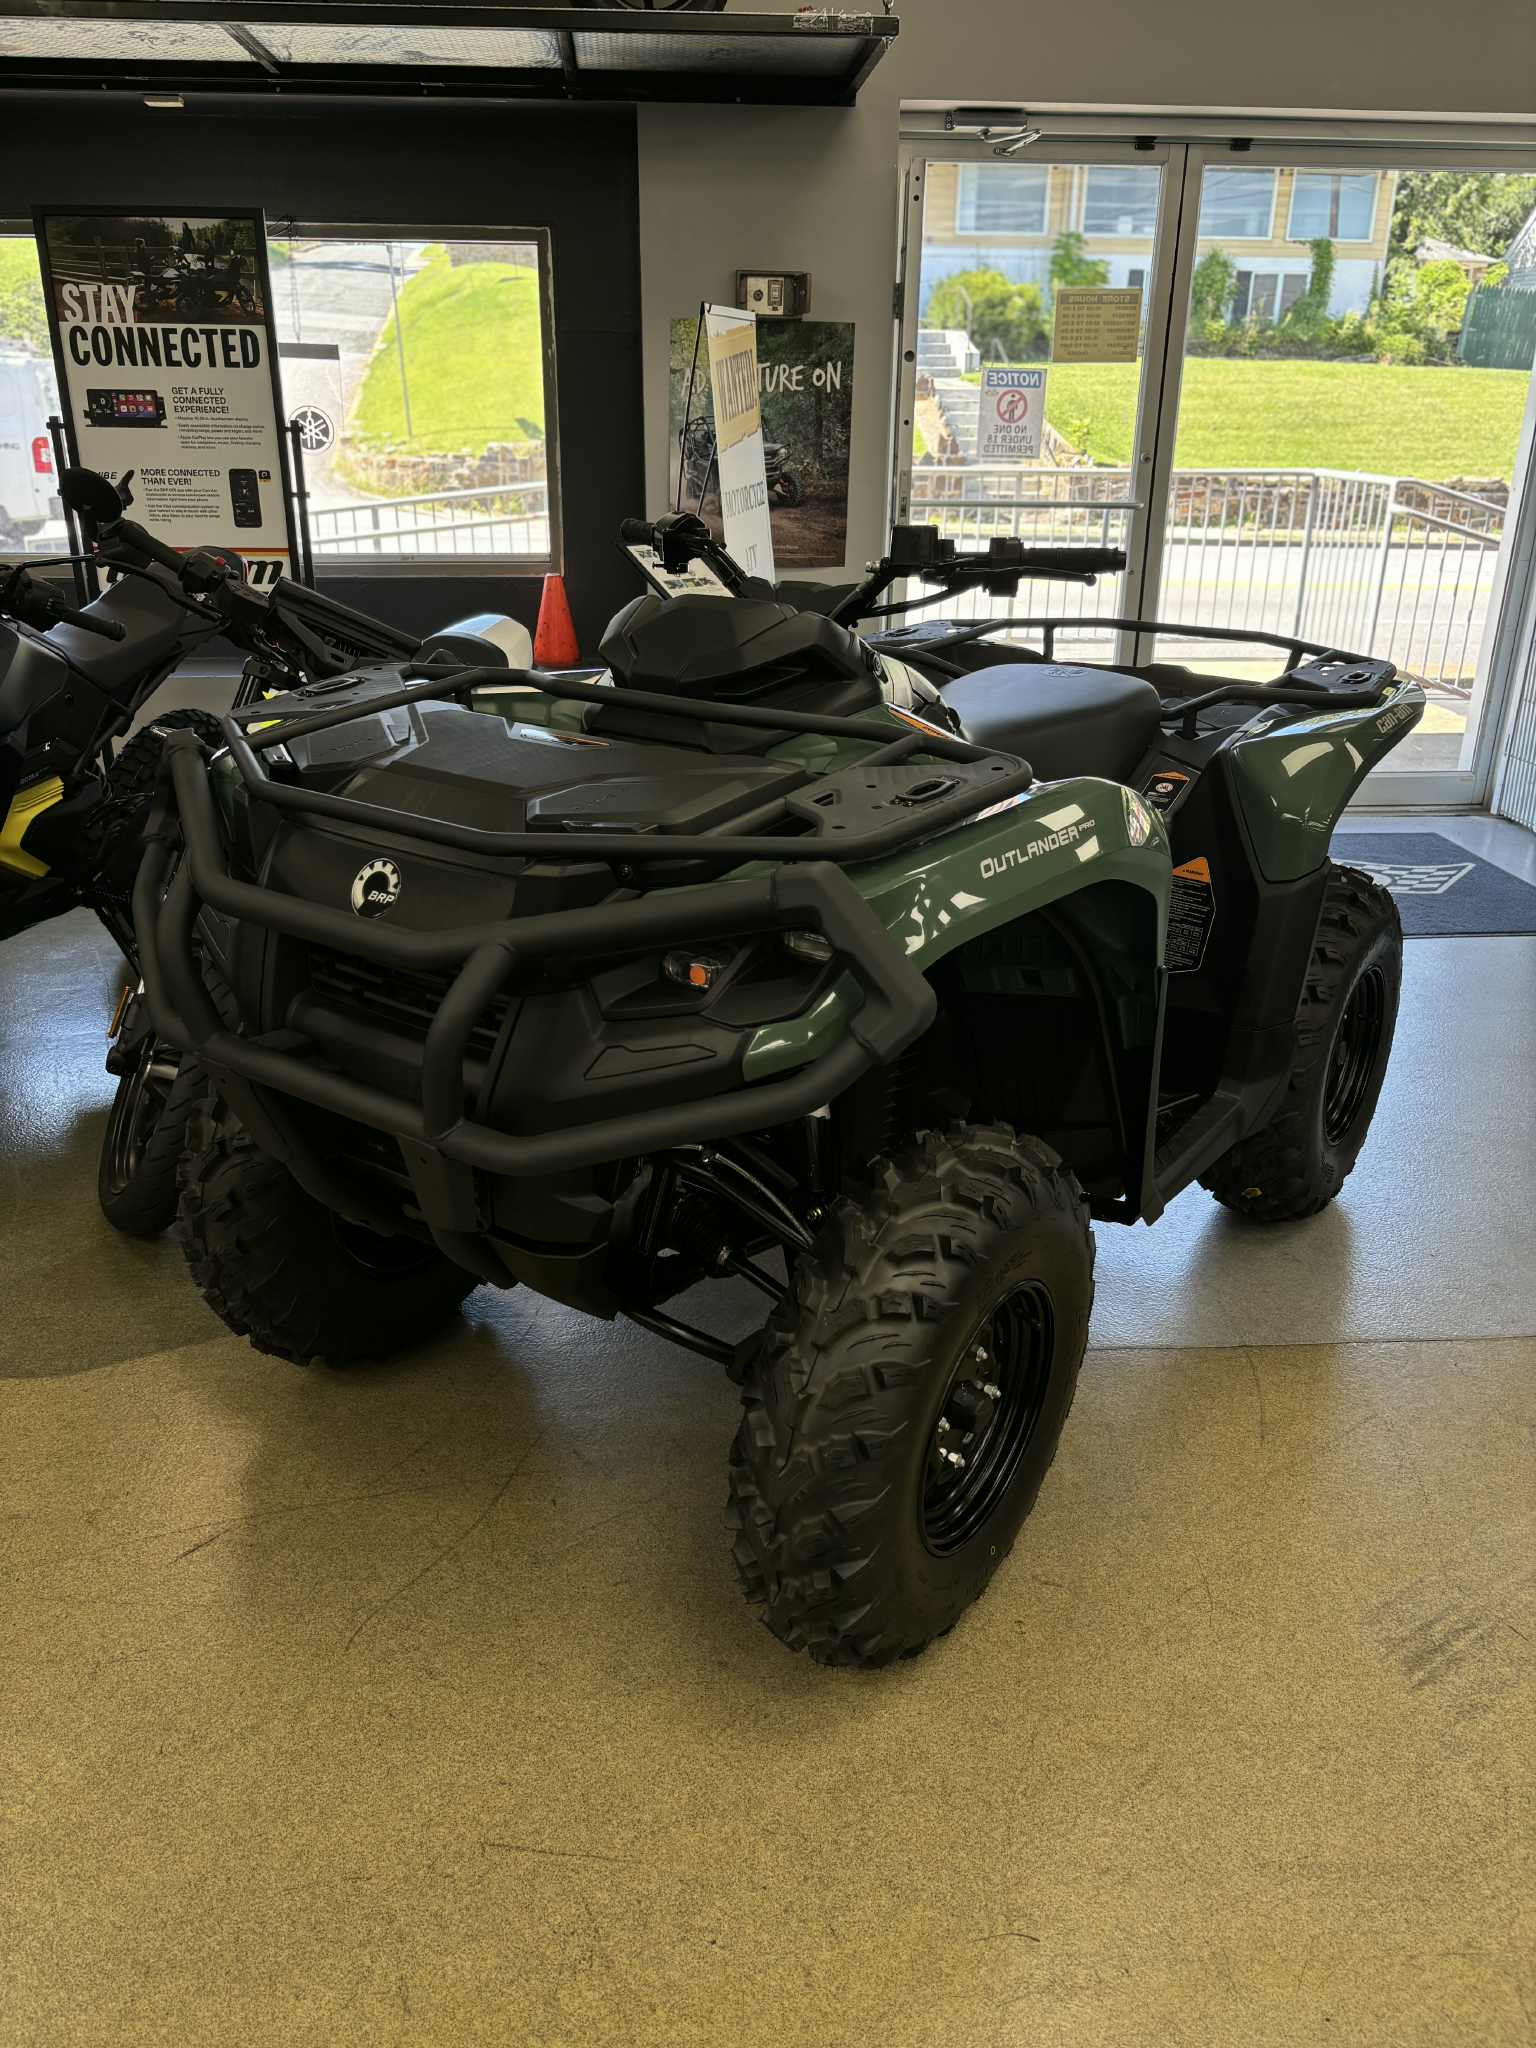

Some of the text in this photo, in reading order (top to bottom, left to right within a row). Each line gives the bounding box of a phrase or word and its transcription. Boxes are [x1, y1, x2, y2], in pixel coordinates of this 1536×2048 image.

[61, 283, 136, 323] STAY
[69, 325, 260, 368] CONNECTED
[812, 361, 842, 393] ON
[171, 386, 224, 396] GET A FULLY
[172, 396, 226, 405] CONNECTED
[174, 405, 230, 414] EXPERIENCE!
[140, 468, 220, 477] MORE CONNECTED
[141, 477, 192, 486] THAN EVER!
[1376, 703, 1414, 733] can-am
[980, 819, 1096, 879] OUTLANDER PRO
[367, 890, 395, 904] BRP
